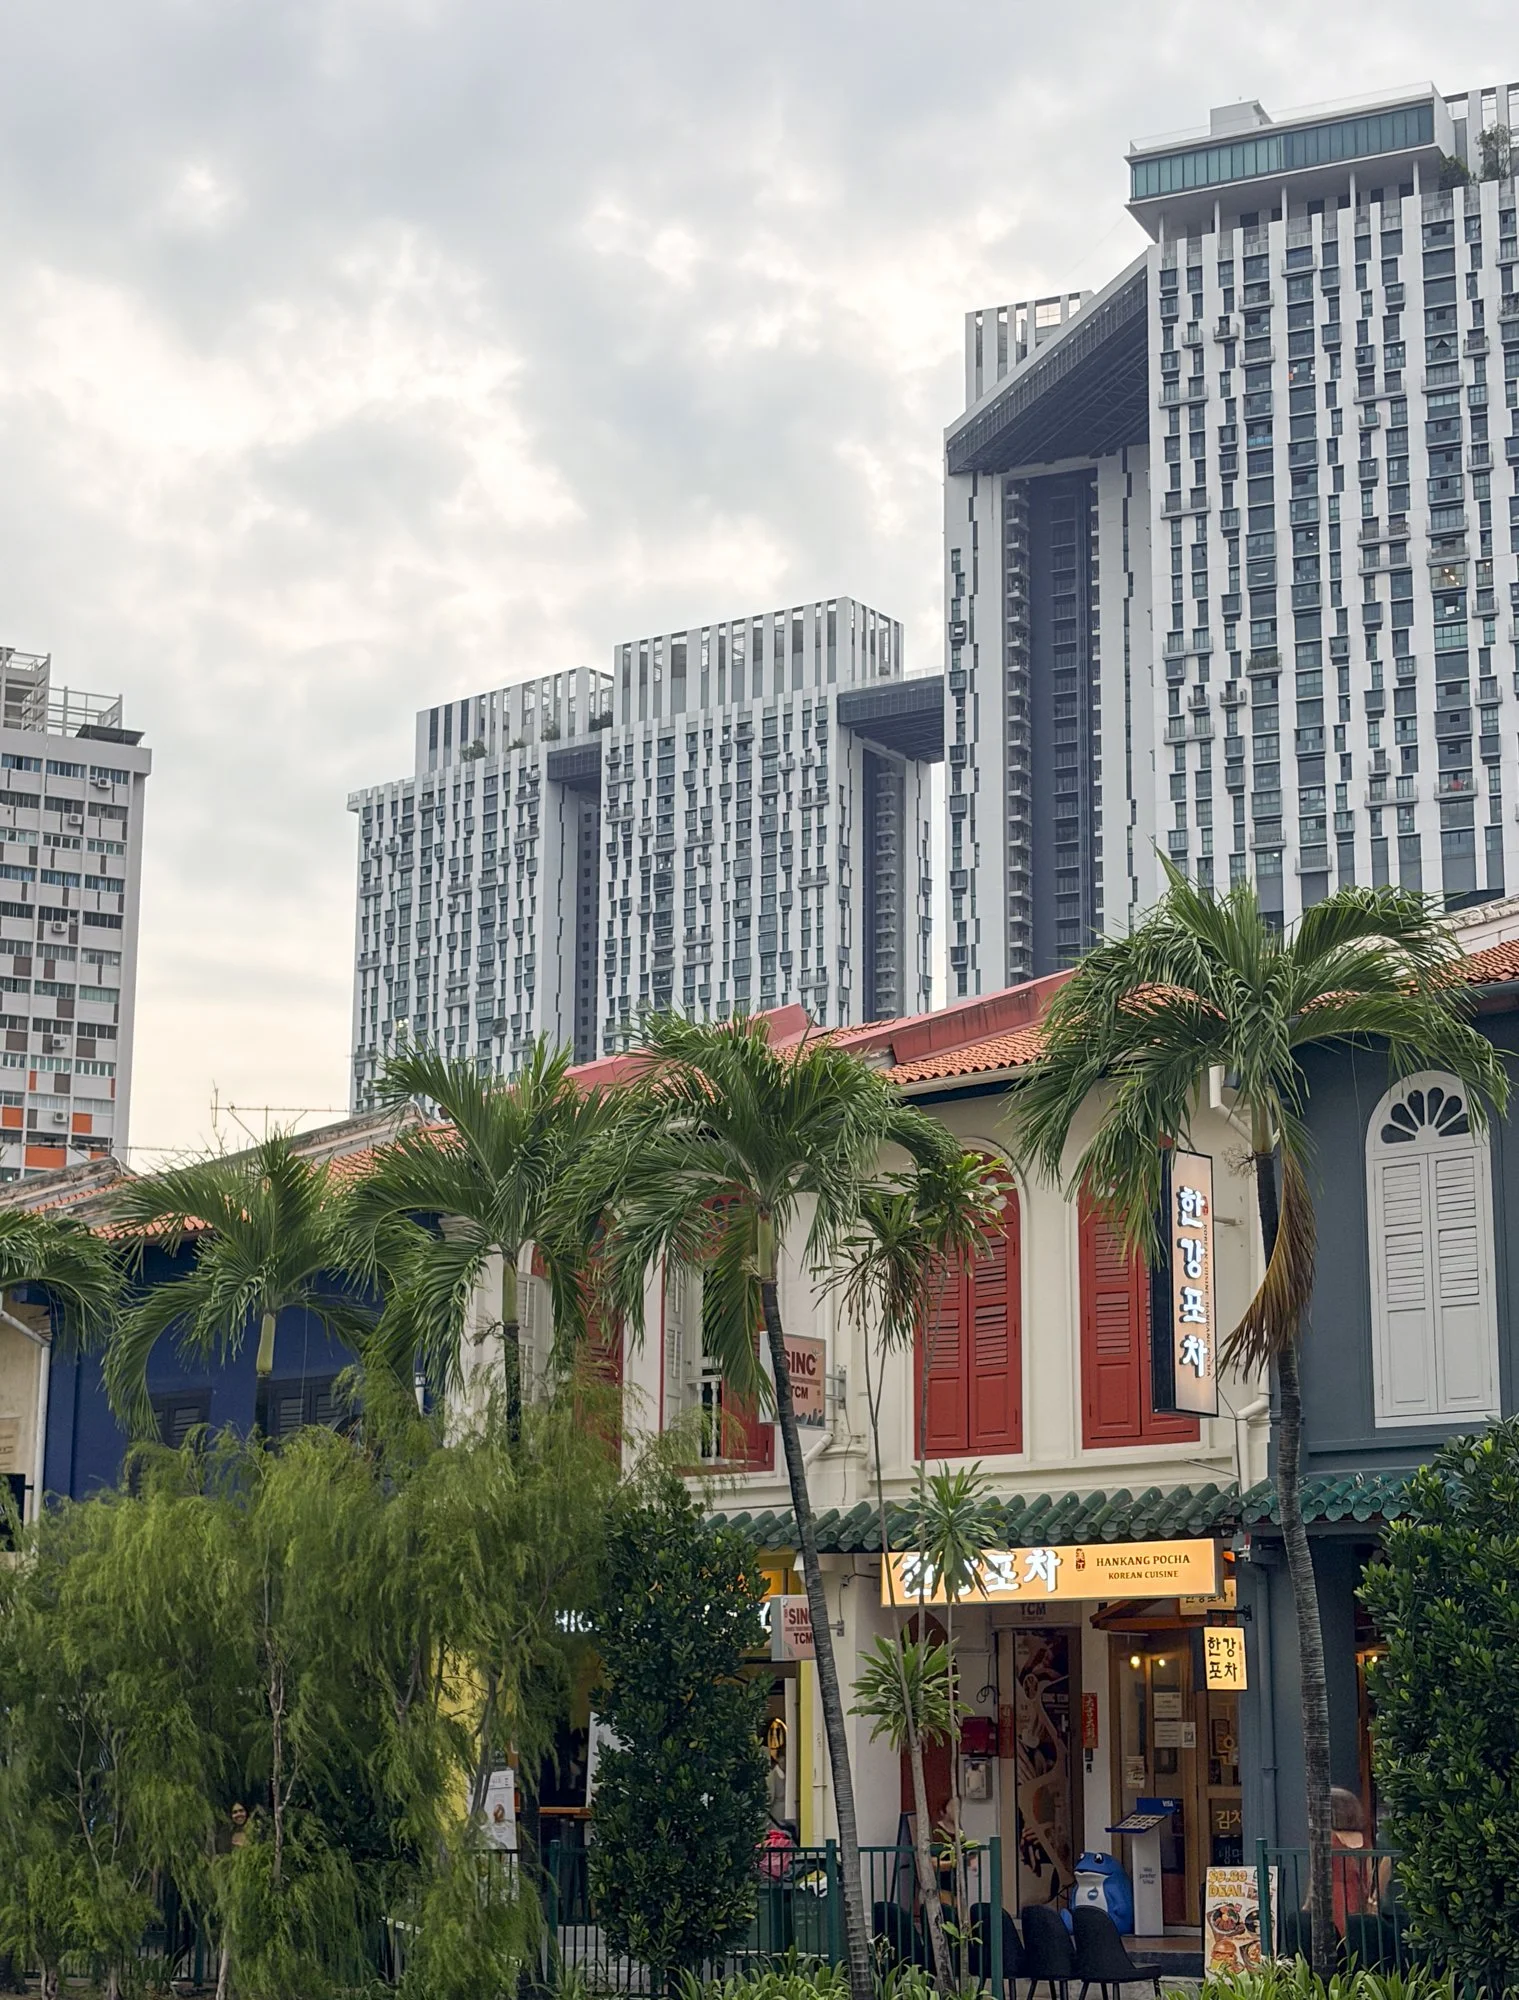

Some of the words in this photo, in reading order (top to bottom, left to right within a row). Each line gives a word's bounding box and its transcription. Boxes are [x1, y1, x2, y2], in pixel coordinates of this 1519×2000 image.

[1177, 1186, 1207, 1377] 한강포차
[1096, 1556, 1150, 1567] HANKANG
[1153, 1554, 1190, 1564] POCHA
[1108, 1572, 1142, 1580] KOREAN
[1145, 1570, 1179, 1578] CUISINE
[789, 1608, 809, 1625] SIN
[1020, 1602, 1046, 1616] TCM
[793, 1632, 813, 1644] TCM
[1207, 1636, 1236, 1657] 한강
[1209, 1661, 1238, 1682] 포차
